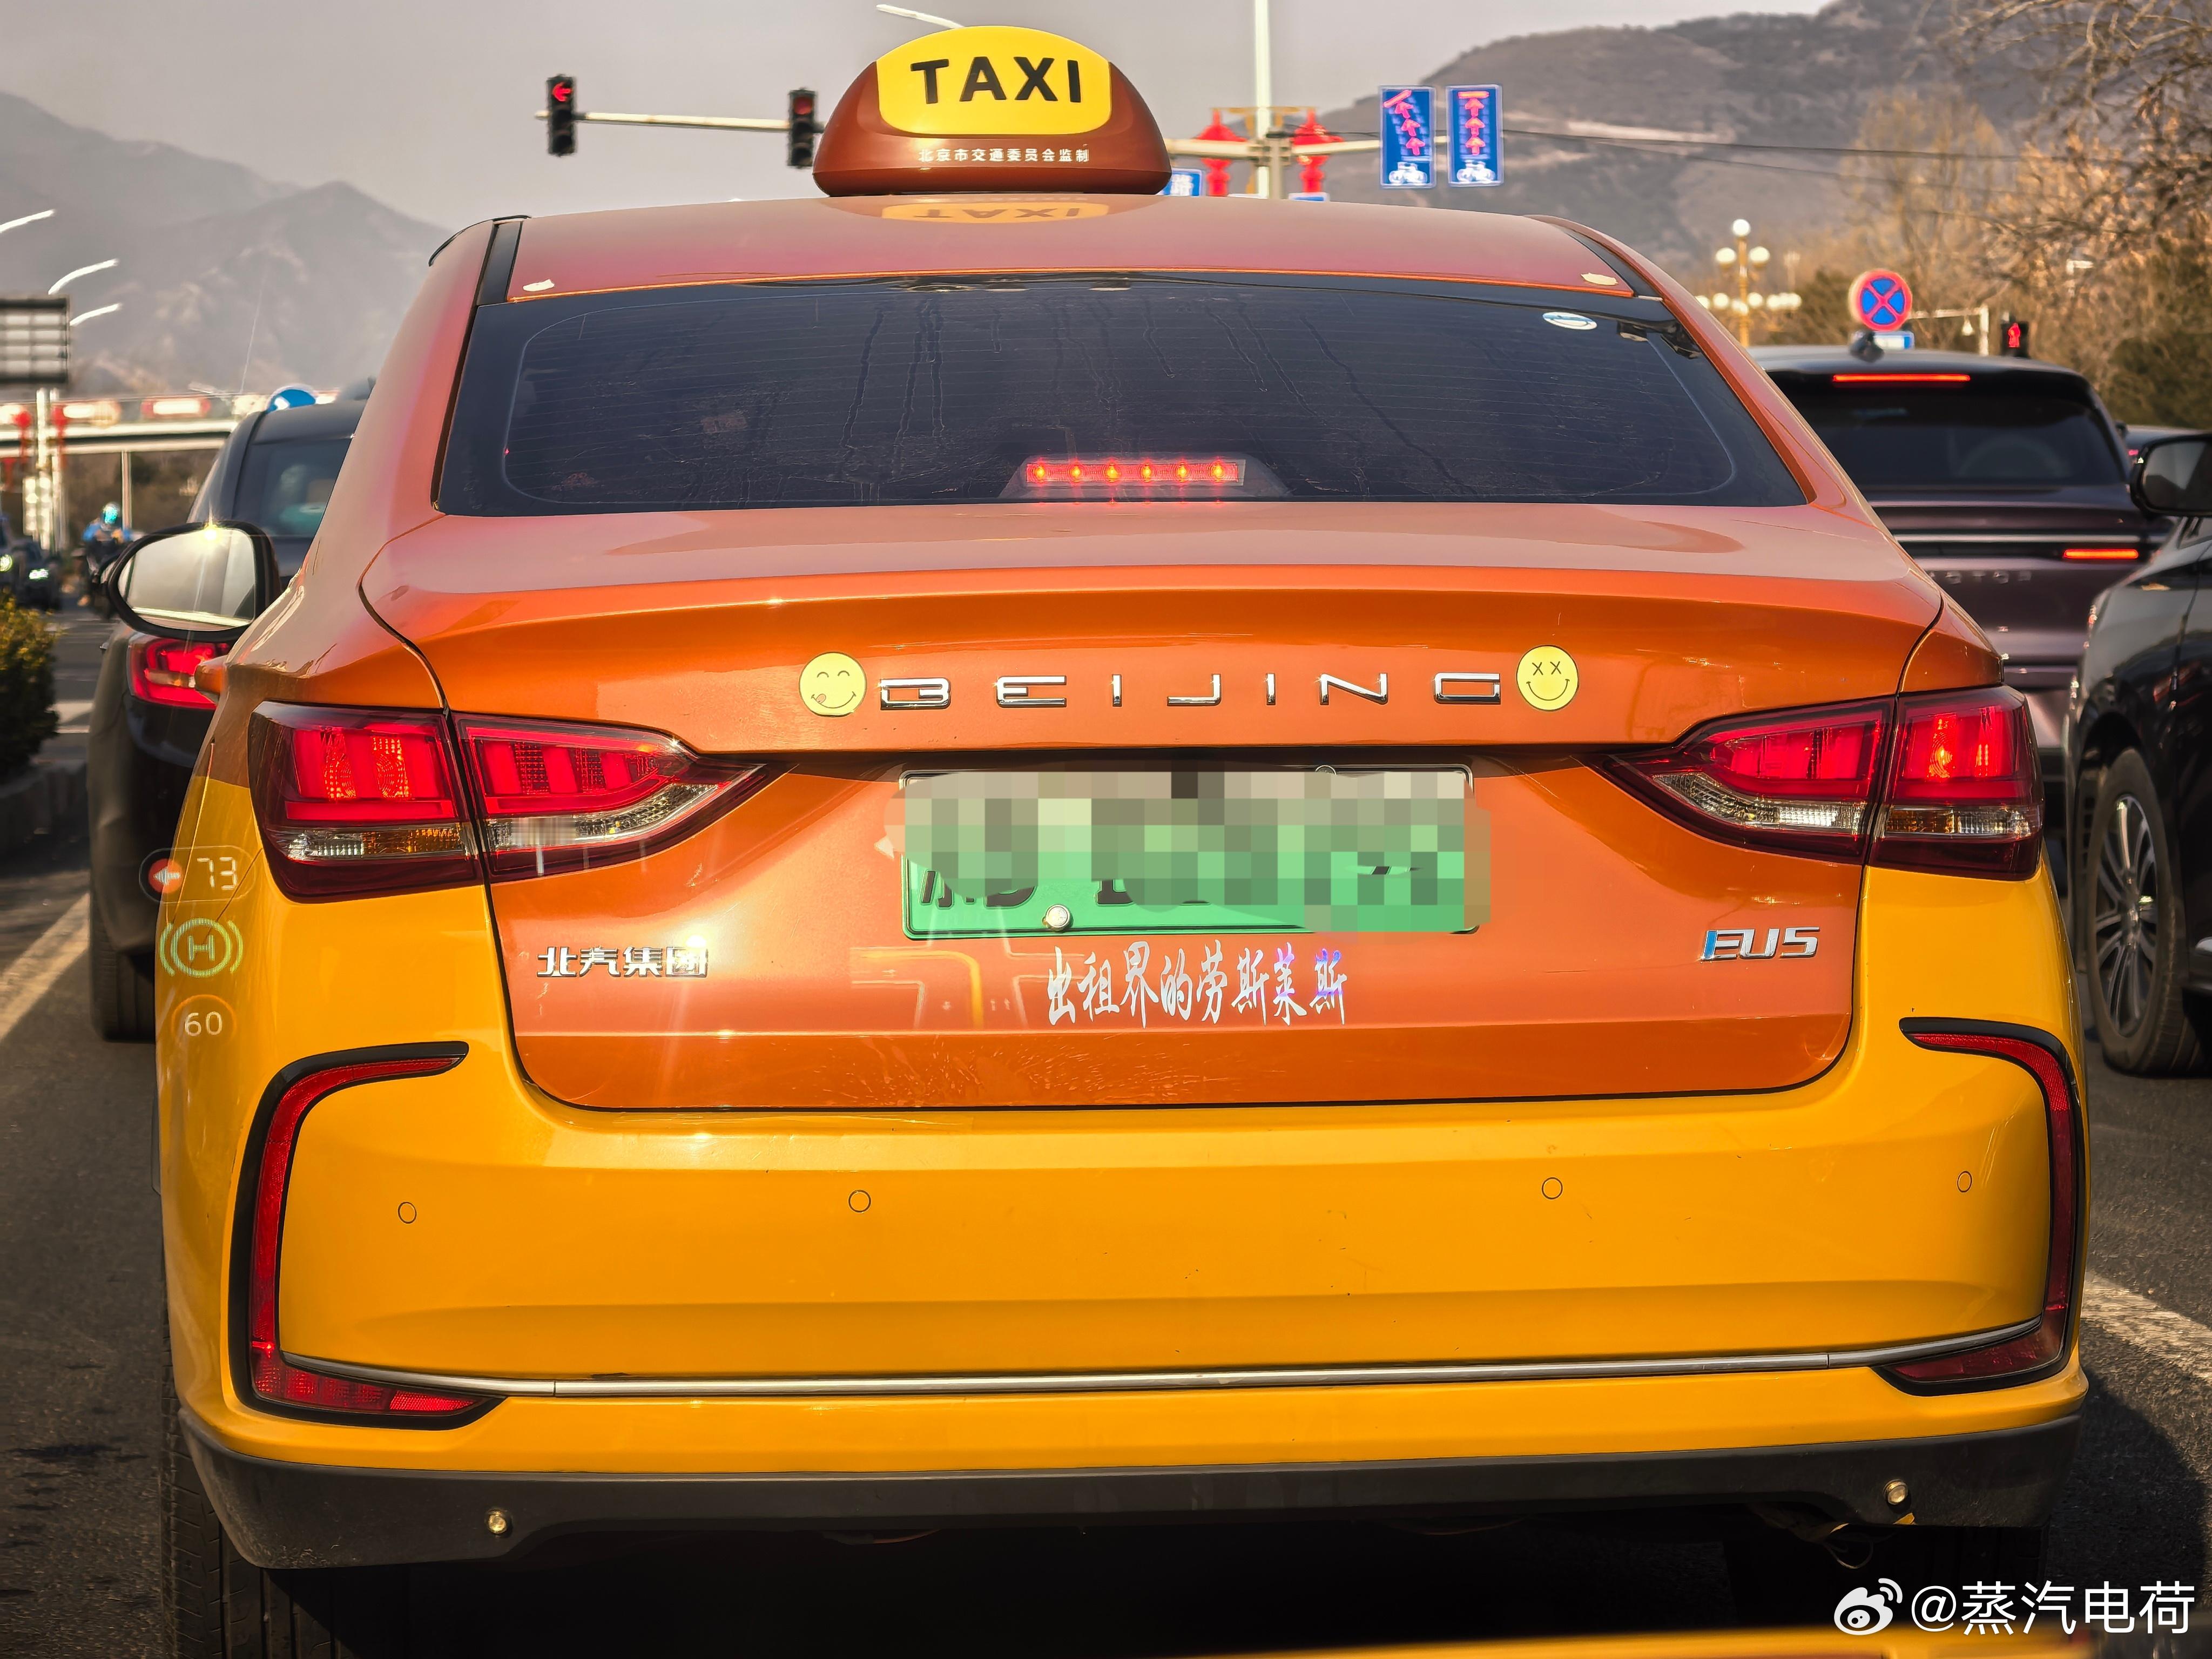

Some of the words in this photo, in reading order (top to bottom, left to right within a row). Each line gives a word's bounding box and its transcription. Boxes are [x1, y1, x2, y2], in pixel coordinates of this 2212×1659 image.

[910, 56, 1081, 104] TAXI
[919, 149, 1089, 163] 北京市交通委员会监制
[880, 672, 1501, 710] BEIJING
[197, 857, 238, 890] 73
[1701, 927, 1820, 961] EU5
[1047, 939, 1347, 1028] 出租界的劳斯莱斯
[184, 1011, 222, 1036] 60
